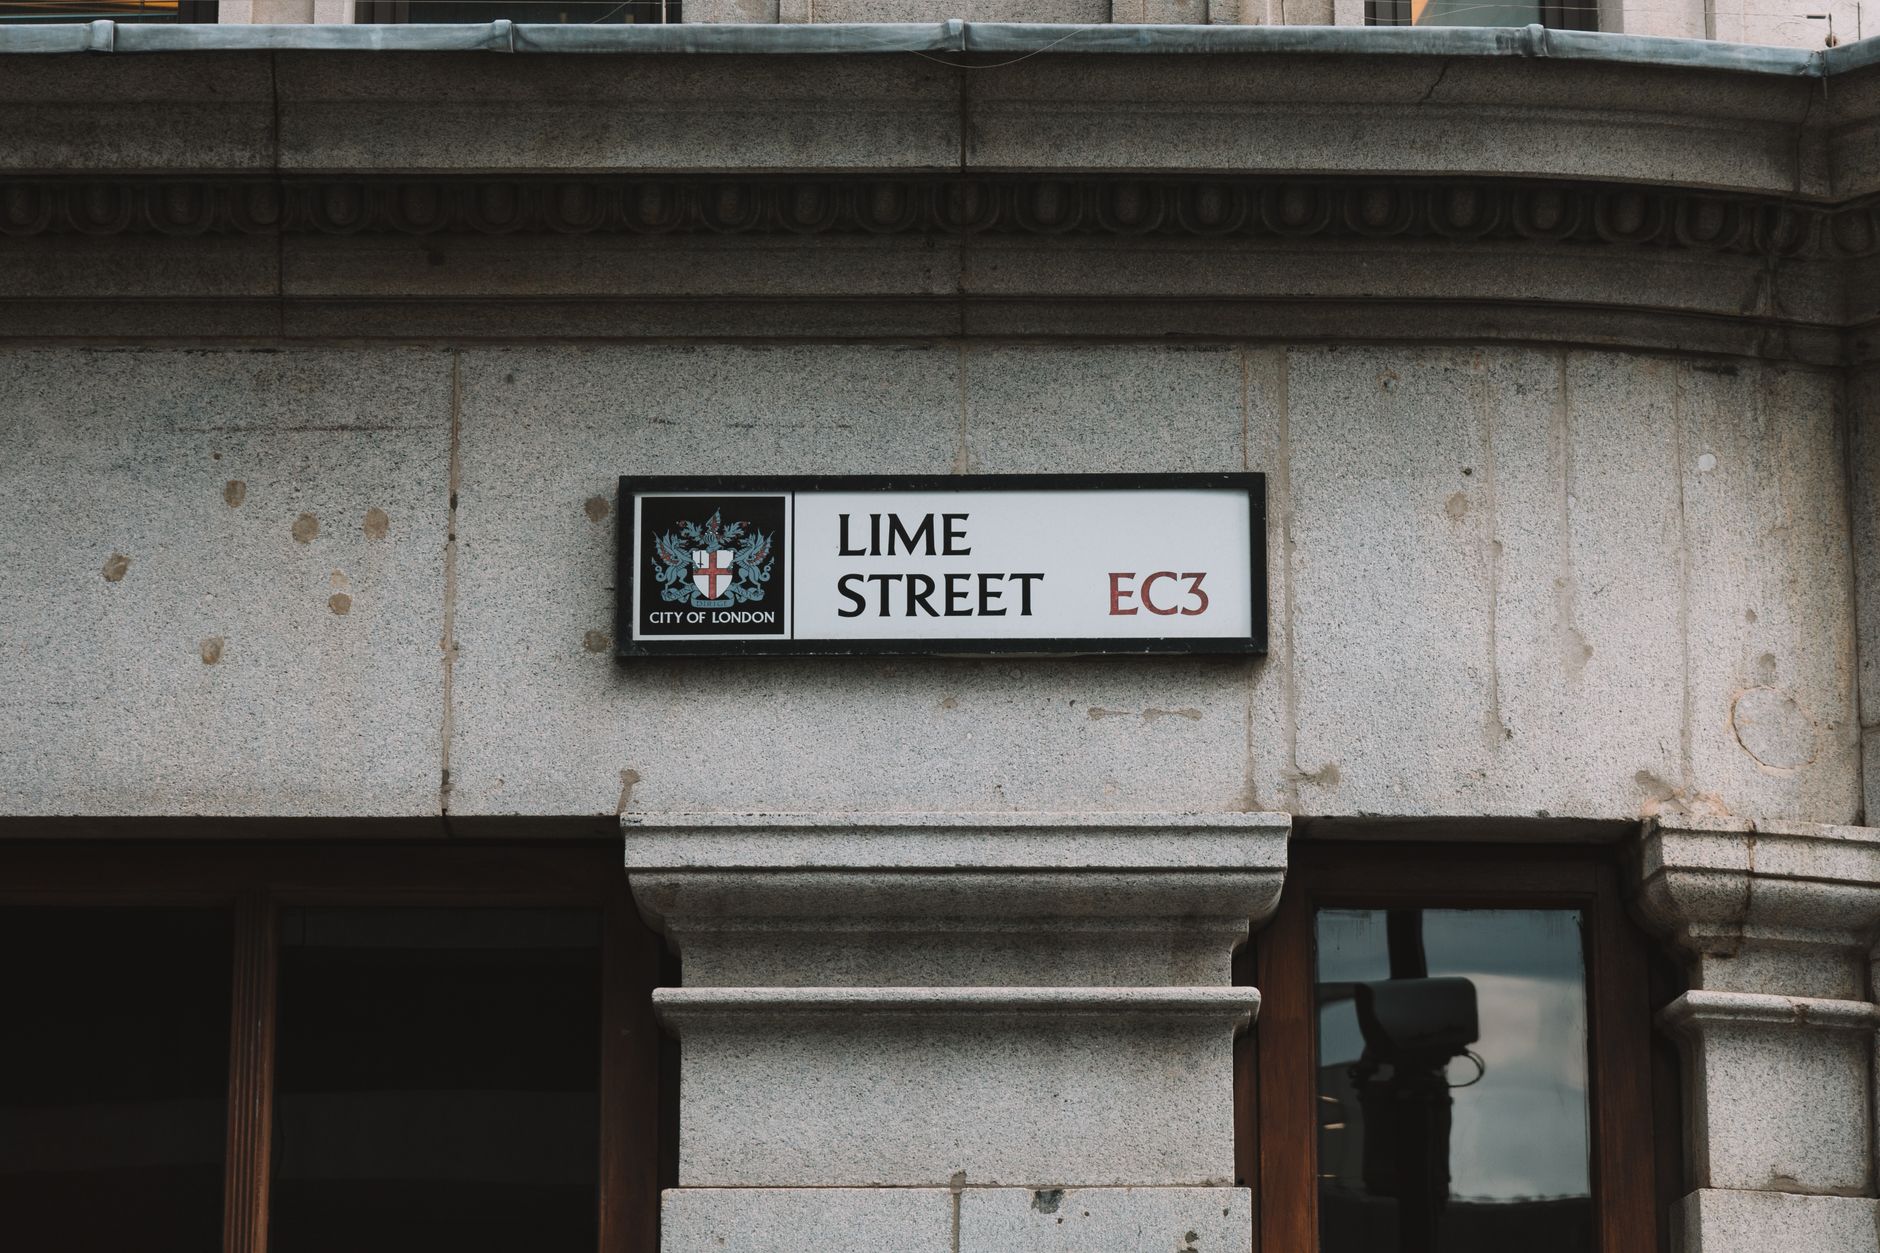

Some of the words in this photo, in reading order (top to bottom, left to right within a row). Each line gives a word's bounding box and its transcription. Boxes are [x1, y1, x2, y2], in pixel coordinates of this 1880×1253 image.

[838, 513, 971, 556] LIME
[838, 573, 1044, 617] STREET
[1108, 571, 1209, 616] EC3
[649, 611, 682, 624] CITY
[686, 611, 706, 624] OF
[712, 611, 775, 624] LONDON
